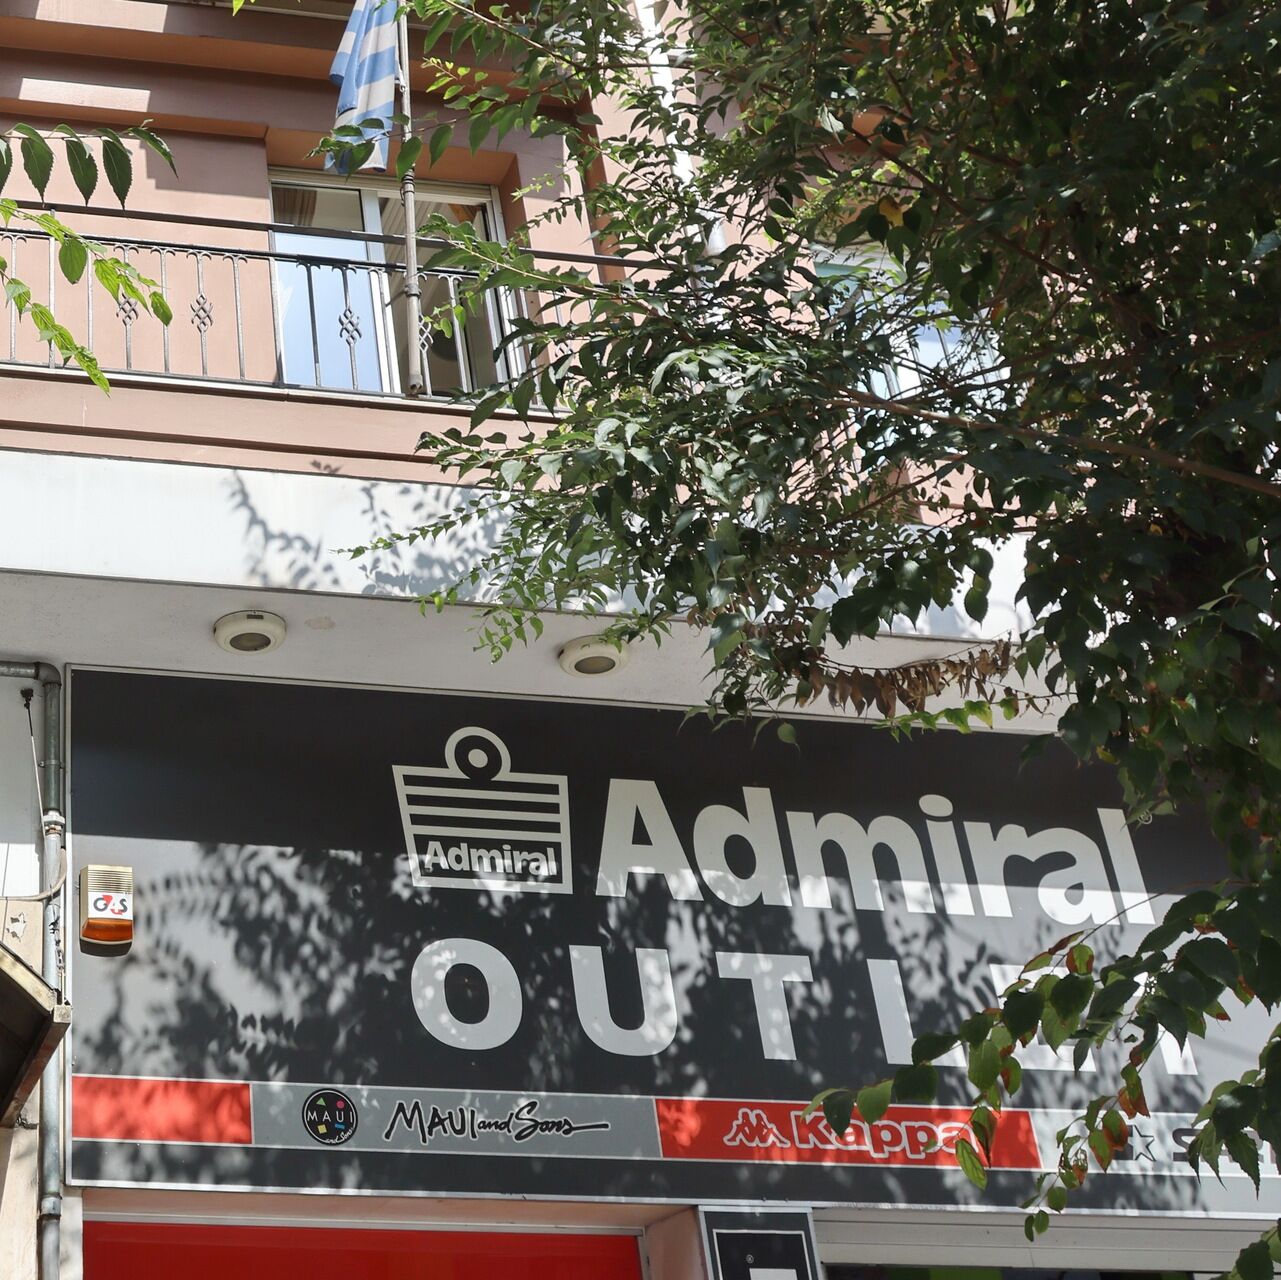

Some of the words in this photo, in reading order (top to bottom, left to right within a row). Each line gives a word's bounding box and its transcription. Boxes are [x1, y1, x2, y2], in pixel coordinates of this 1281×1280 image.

[423, 838, 556, 877] Admiral
[596, 778, 1155, 925] Admiral
[307, 1110, 353, 1123] MAUI
[790, 1110, 980, 1159] Kappa
